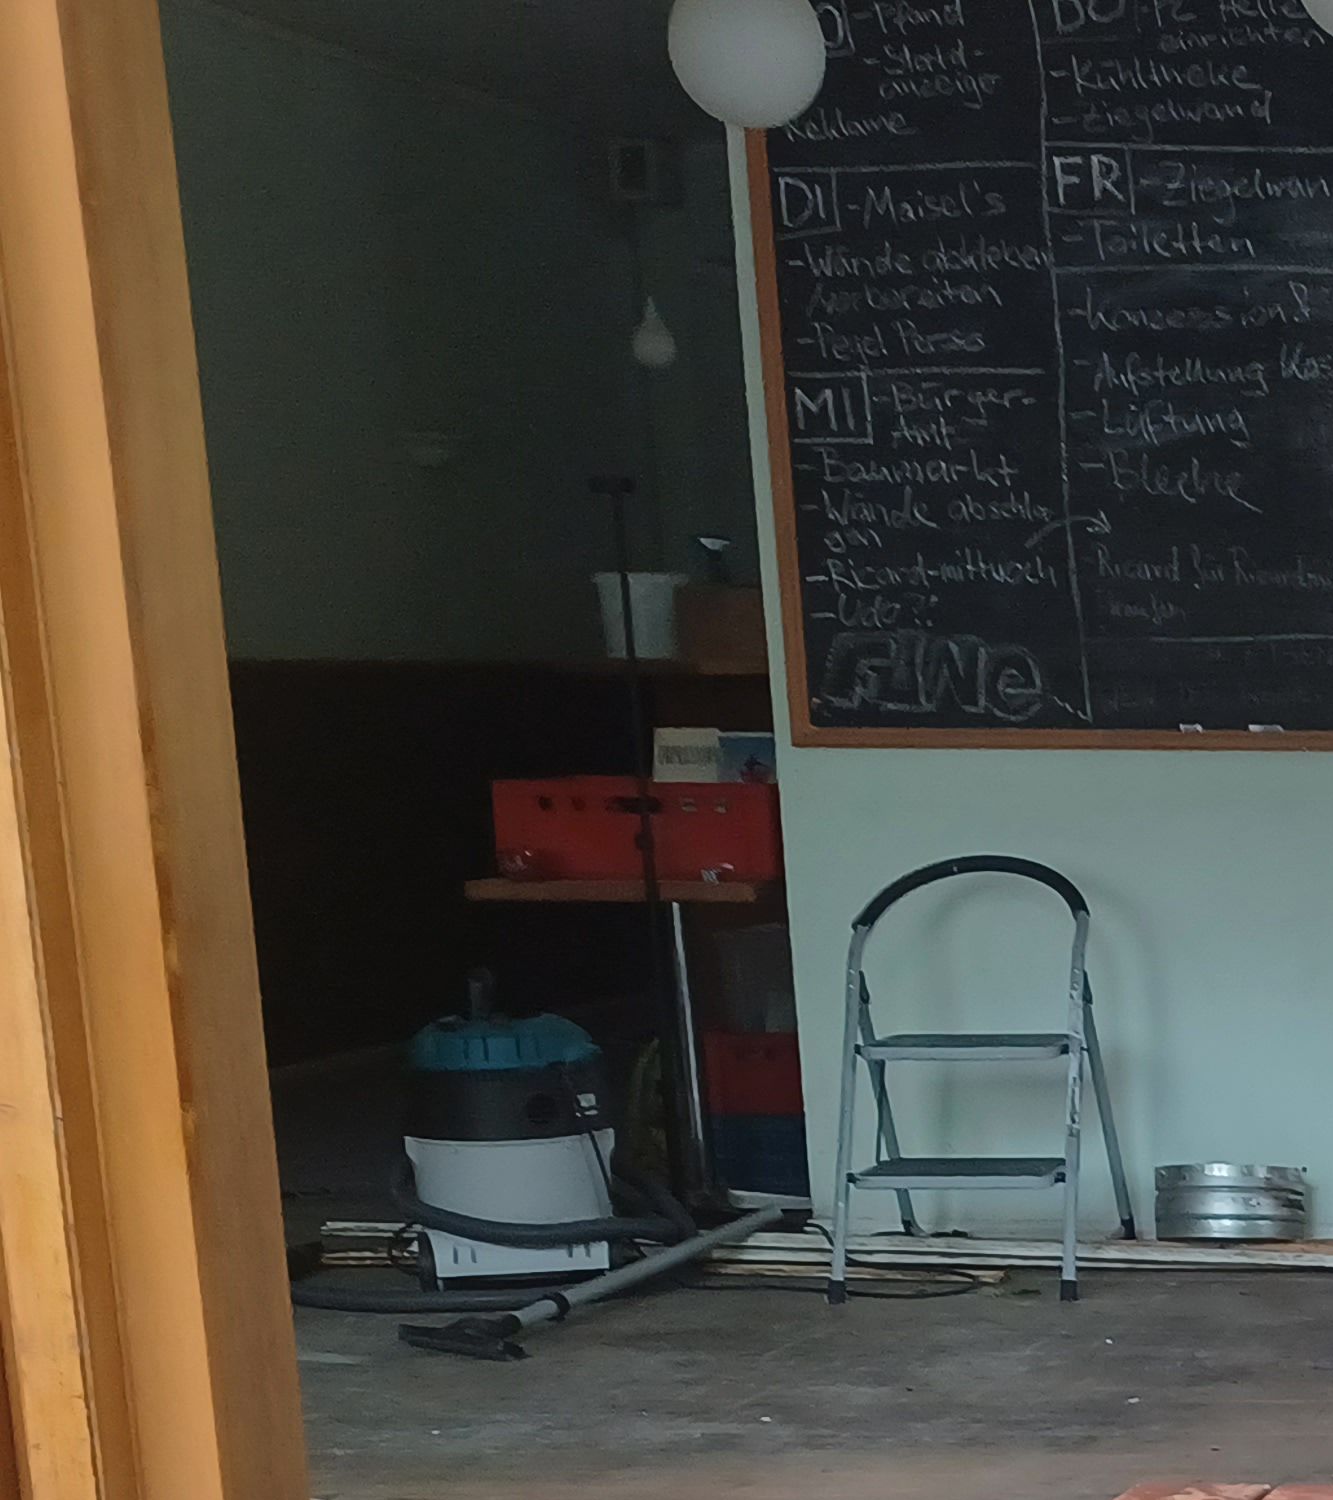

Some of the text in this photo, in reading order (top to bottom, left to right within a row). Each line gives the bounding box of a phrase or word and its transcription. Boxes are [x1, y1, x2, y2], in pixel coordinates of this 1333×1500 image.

[779, 176, 827, 229] DI
[1053, 153, 1128, 207] FR
[794, 385, 855, 431] MI
